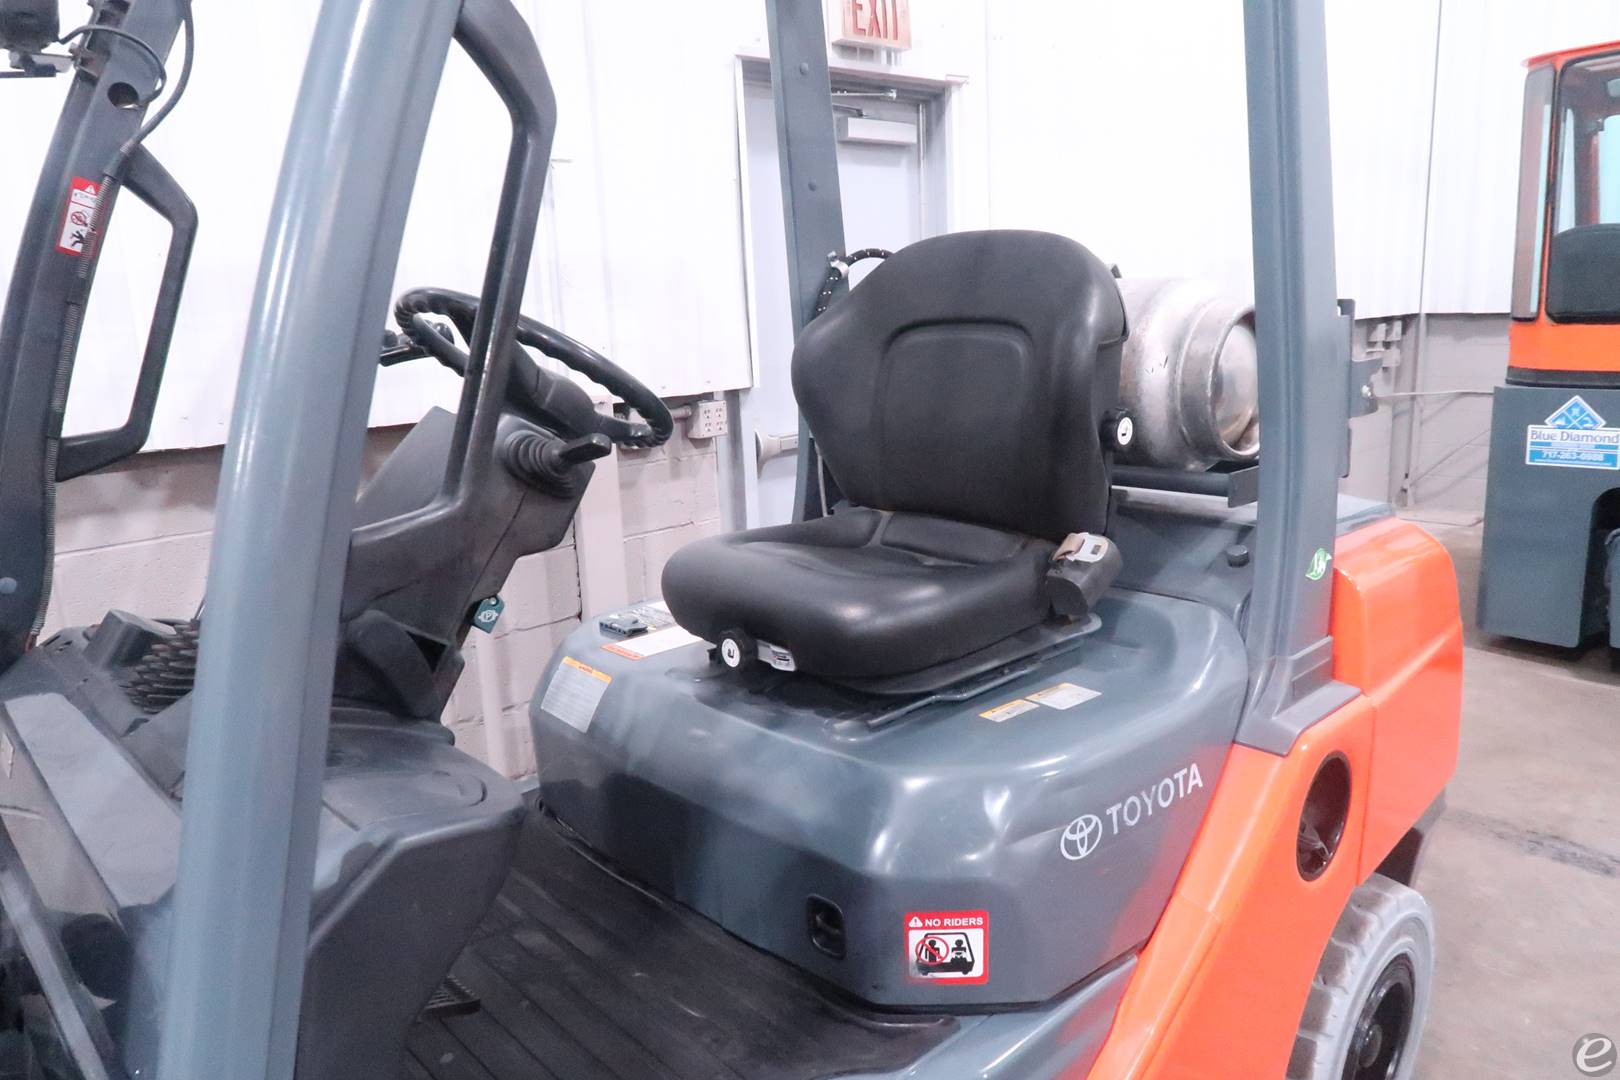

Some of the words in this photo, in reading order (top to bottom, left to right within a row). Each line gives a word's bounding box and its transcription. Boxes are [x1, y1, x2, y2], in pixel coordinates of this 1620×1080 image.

[1530, 430, 1557, 441] Blue
[1560, 431, 1620, 444] Diamond
[1106, 763, 1203, 835] TOYOTA
[925, 918, 941, 927] NO
[944, 917, 983, 927] RIDERS
